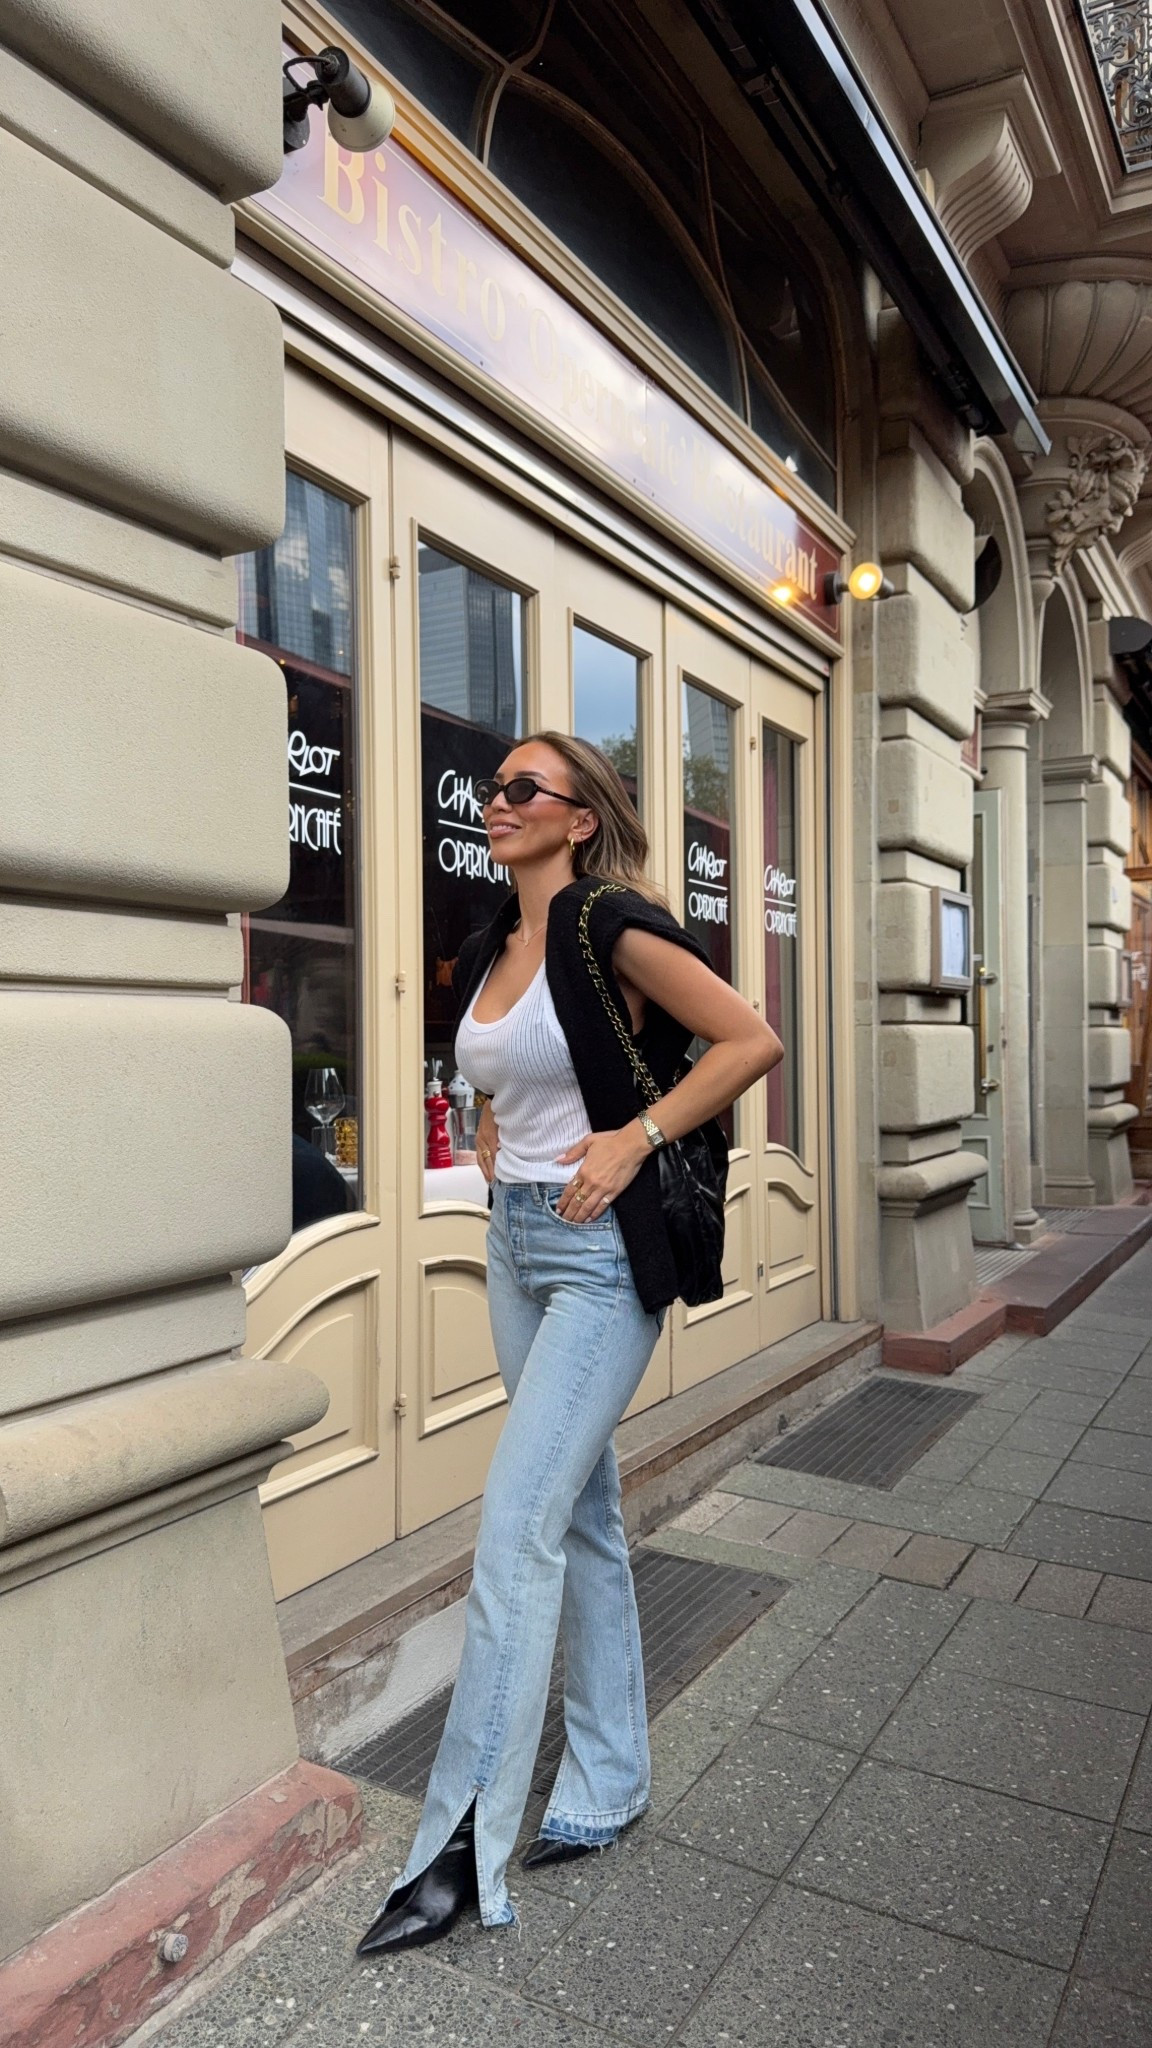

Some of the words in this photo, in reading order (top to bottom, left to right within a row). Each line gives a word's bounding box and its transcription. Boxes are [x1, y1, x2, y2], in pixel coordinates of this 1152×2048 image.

[316, 104, 506, 342] Bistro
[691, 435, 819, 601] Restaurant
[287, 730, 341, 777] RLOT
[437, 769, 489, 824] CHAR
[438, 837, 512, 887] OPERNC
[687, 841, 728, 880] CHARLOT
[763, 864, 797, 898] CHARLOT
[688, 891, 729, 926] OPERNCAFÉ
